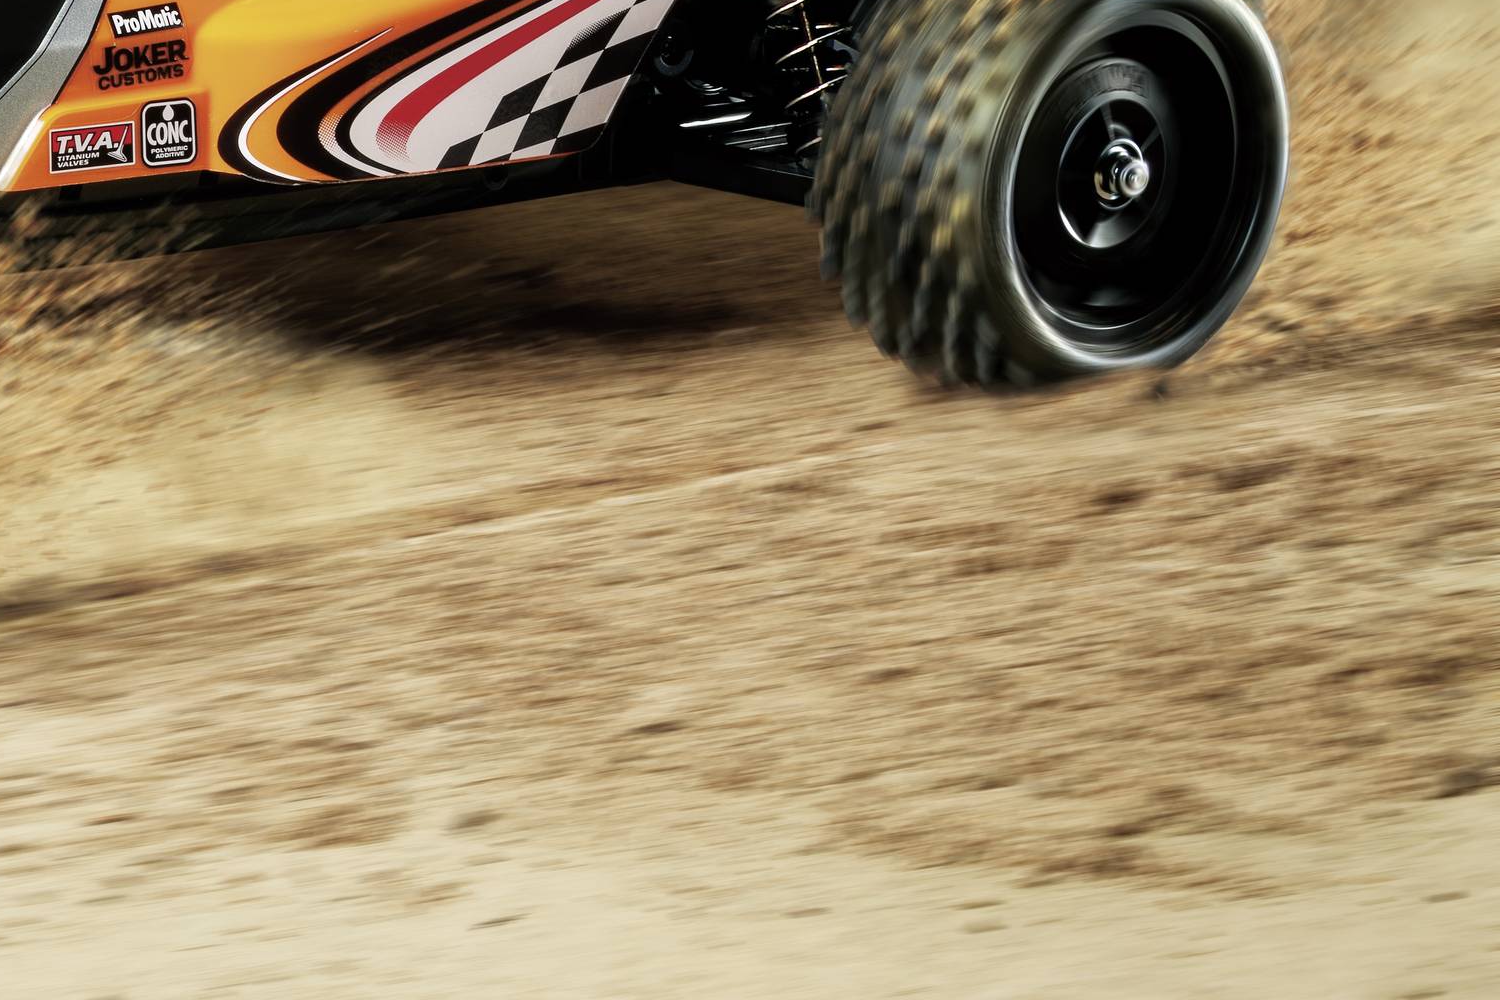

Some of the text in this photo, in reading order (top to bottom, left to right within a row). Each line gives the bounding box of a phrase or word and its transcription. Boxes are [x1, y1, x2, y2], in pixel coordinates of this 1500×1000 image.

[111, 5, 182, 35] ProMatic
[92, 39, 190, 75] JOKER
[98, 64, 184, 90] CUSTOMS
[57, 131, 119, 155] T.V.A.
[150, 145, 189, 155] POLYMERIC
[57, 152, 100, 163] TITANIUM
[57, 159, 90, 169] VALVES
[155, 151, 185, 160] ADDITIVE
